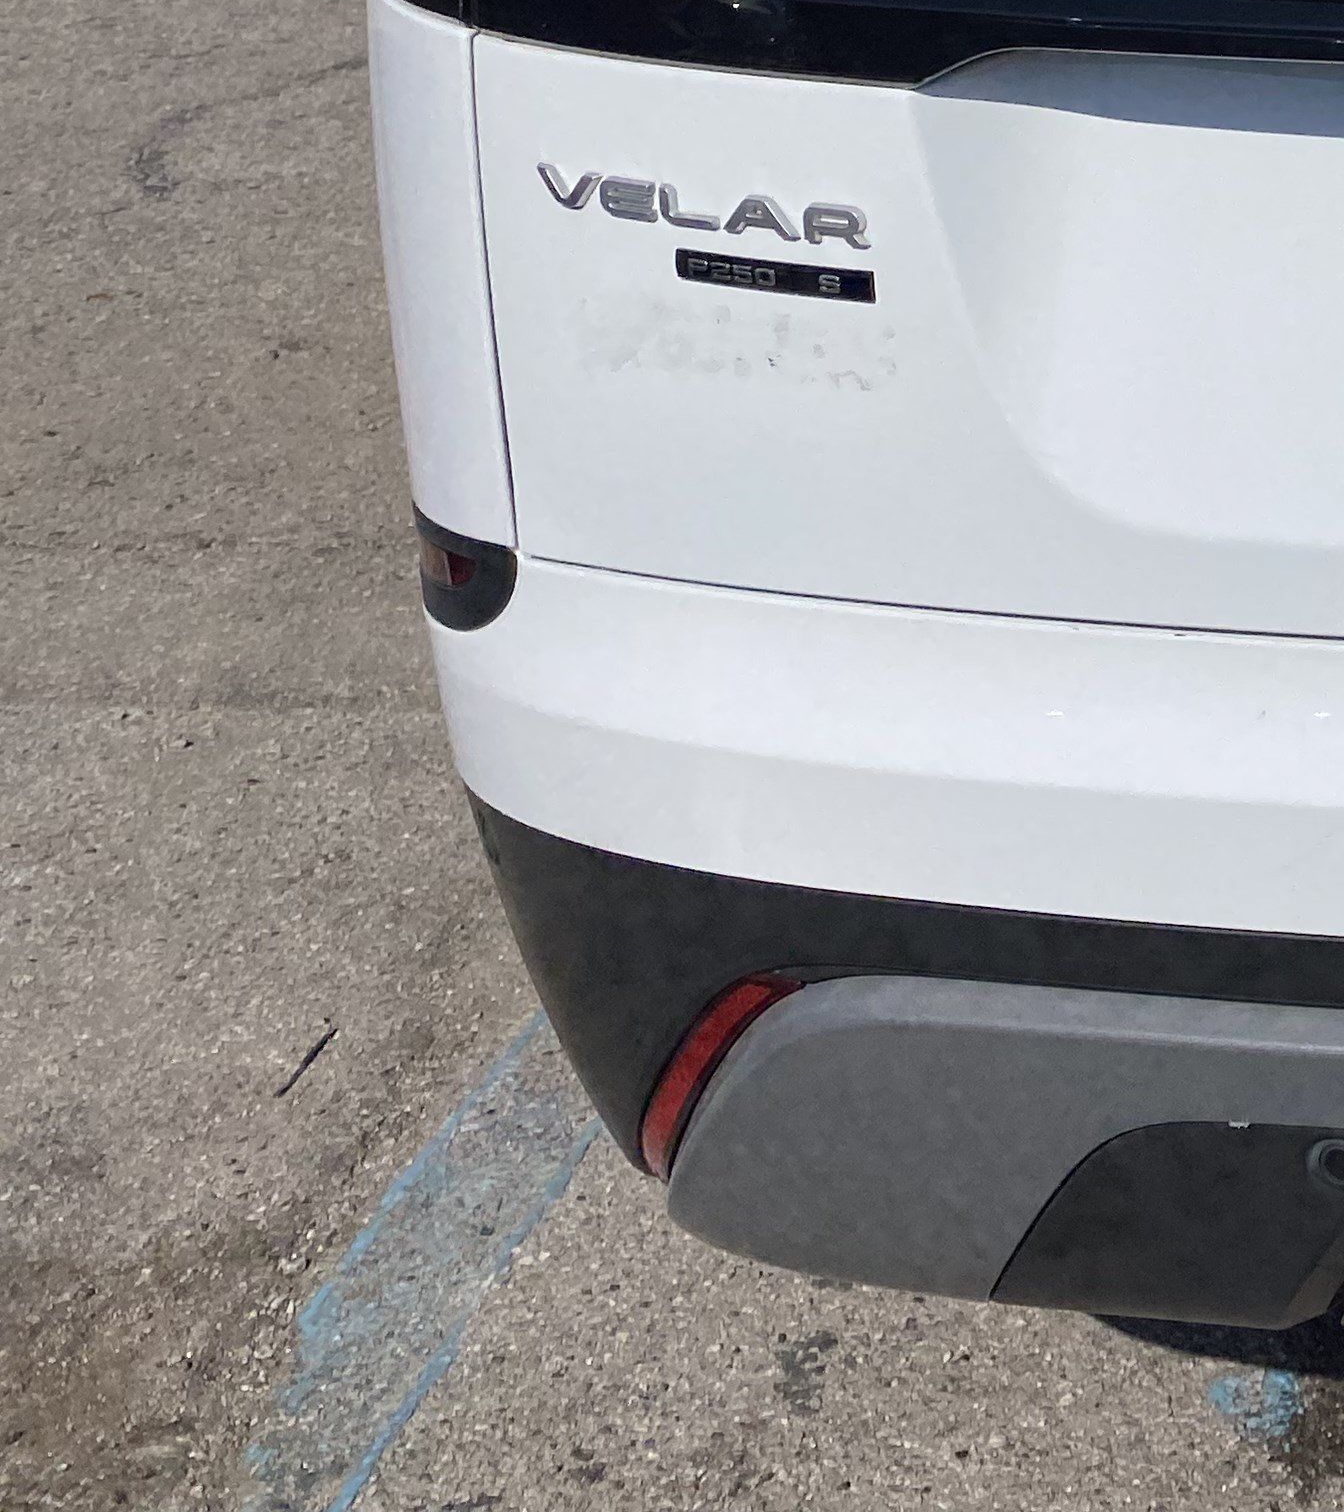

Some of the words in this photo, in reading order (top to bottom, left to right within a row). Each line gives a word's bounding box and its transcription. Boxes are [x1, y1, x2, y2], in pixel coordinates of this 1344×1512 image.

[536, 161, 872, 250] VELAR
[687, 257, 776, 287] P250
[818, 274, 842, 294] S
